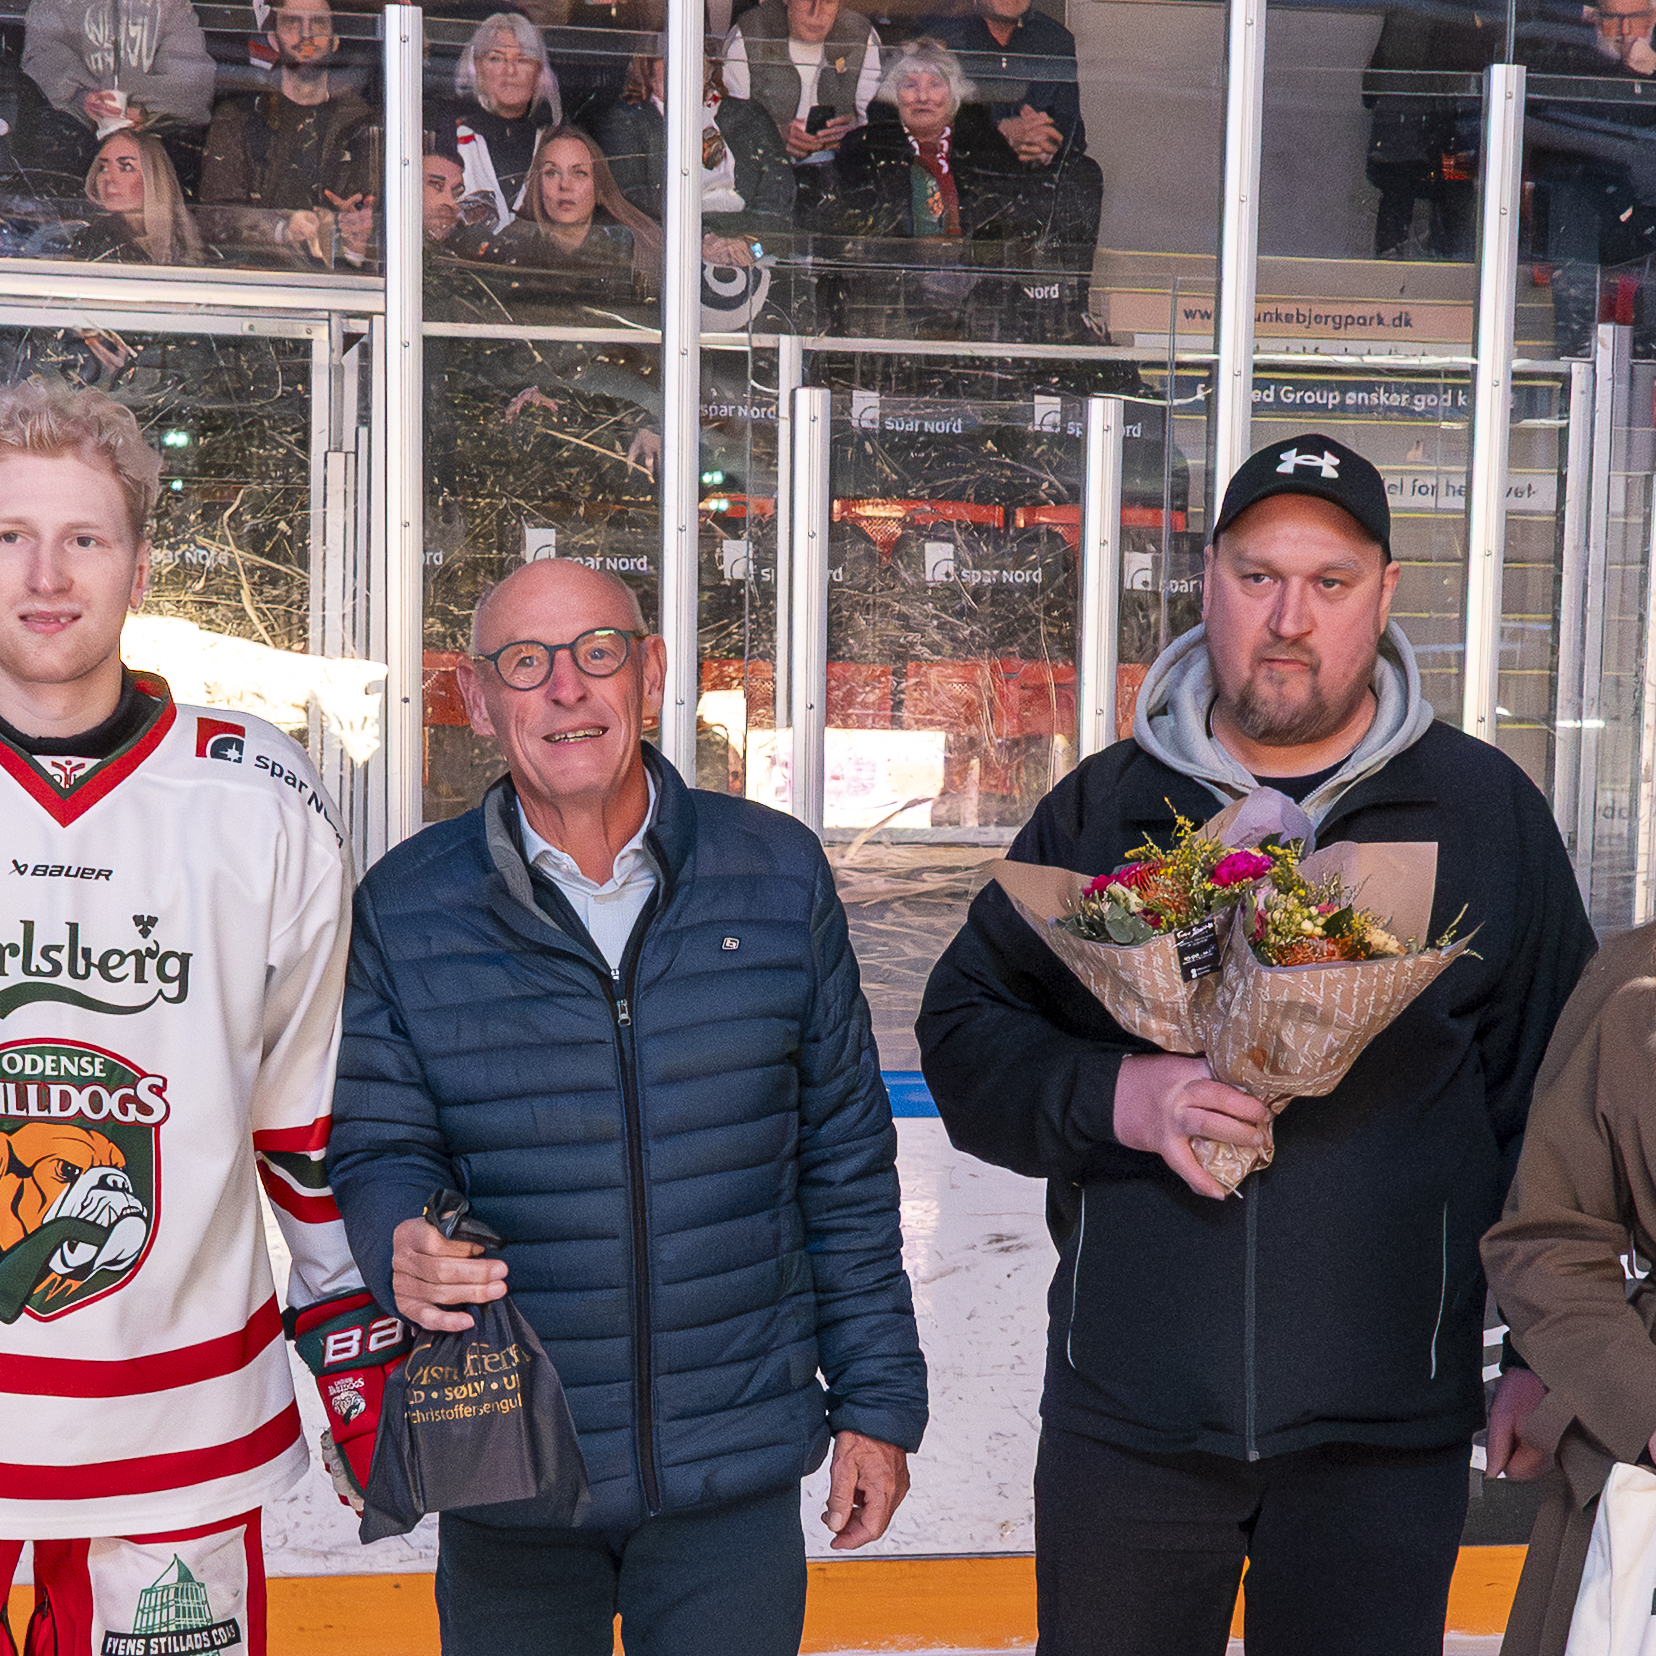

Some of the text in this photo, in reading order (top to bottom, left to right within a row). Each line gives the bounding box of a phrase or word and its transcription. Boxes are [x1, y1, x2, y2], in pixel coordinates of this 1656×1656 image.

[1280, 386, 1341, 409] Group
[1414, 390, 1452, 411] god
[1, 1053, 107, 1078] ODENSE
[445, 1380, 485, 1402] SØLV
[106, 1634, 147, 1656] FYENS
[149, 1627, 212, 1656] STILLADS
